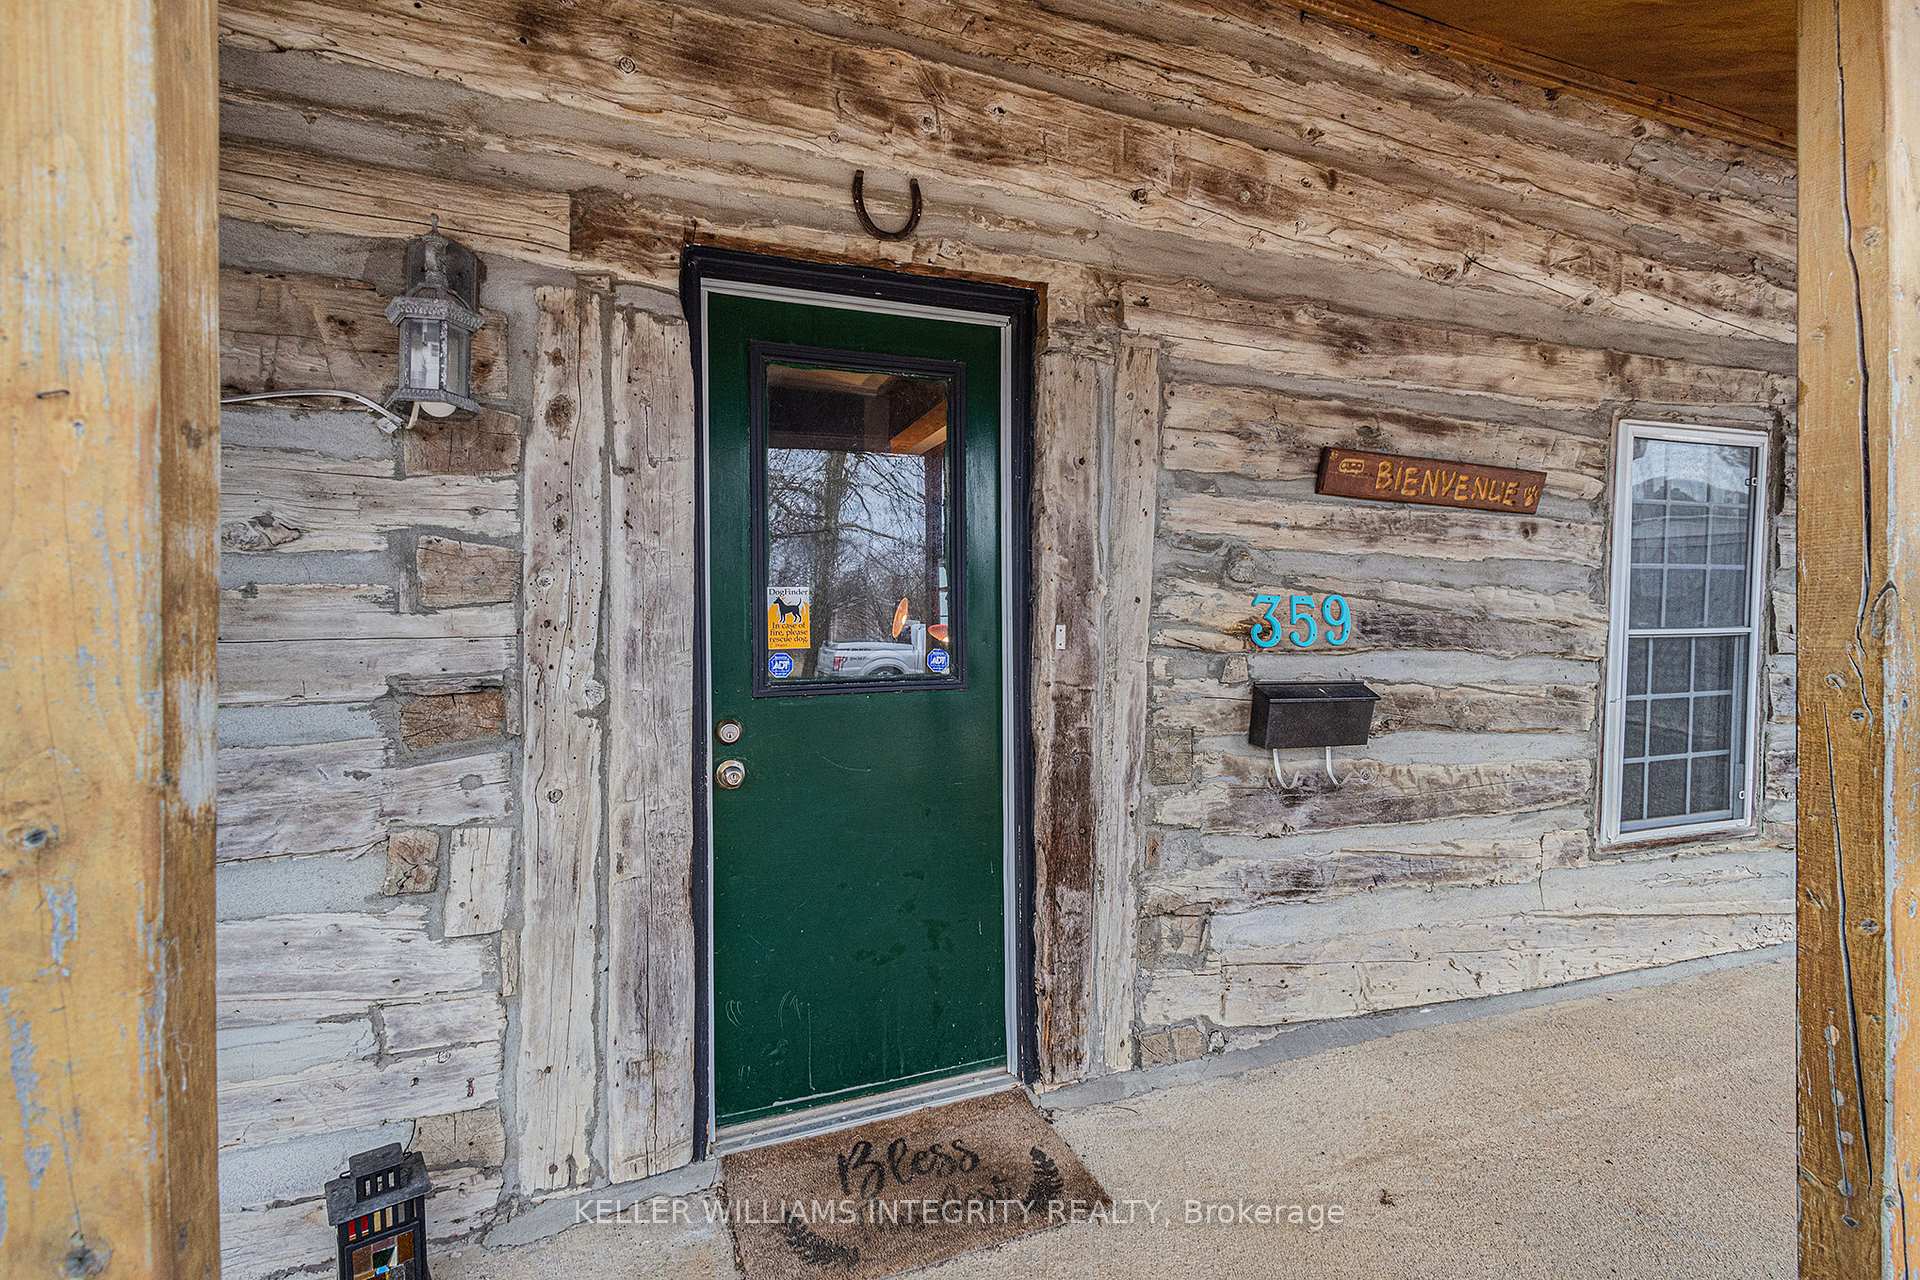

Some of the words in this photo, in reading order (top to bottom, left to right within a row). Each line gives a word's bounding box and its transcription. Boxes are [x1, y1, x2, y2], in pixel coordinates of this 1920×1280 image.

[1375, 460, 1520, 507] BIENVENUE
[768, 588, 809, 597] DogFinder
[1250, 593, 1352, 649] 359
[786, 628, 808, 638] please
[772, 660, 789, 671] ADT
[930, 656, 946, 665] ADT
[837, 1137, 980, 1199] Bless
